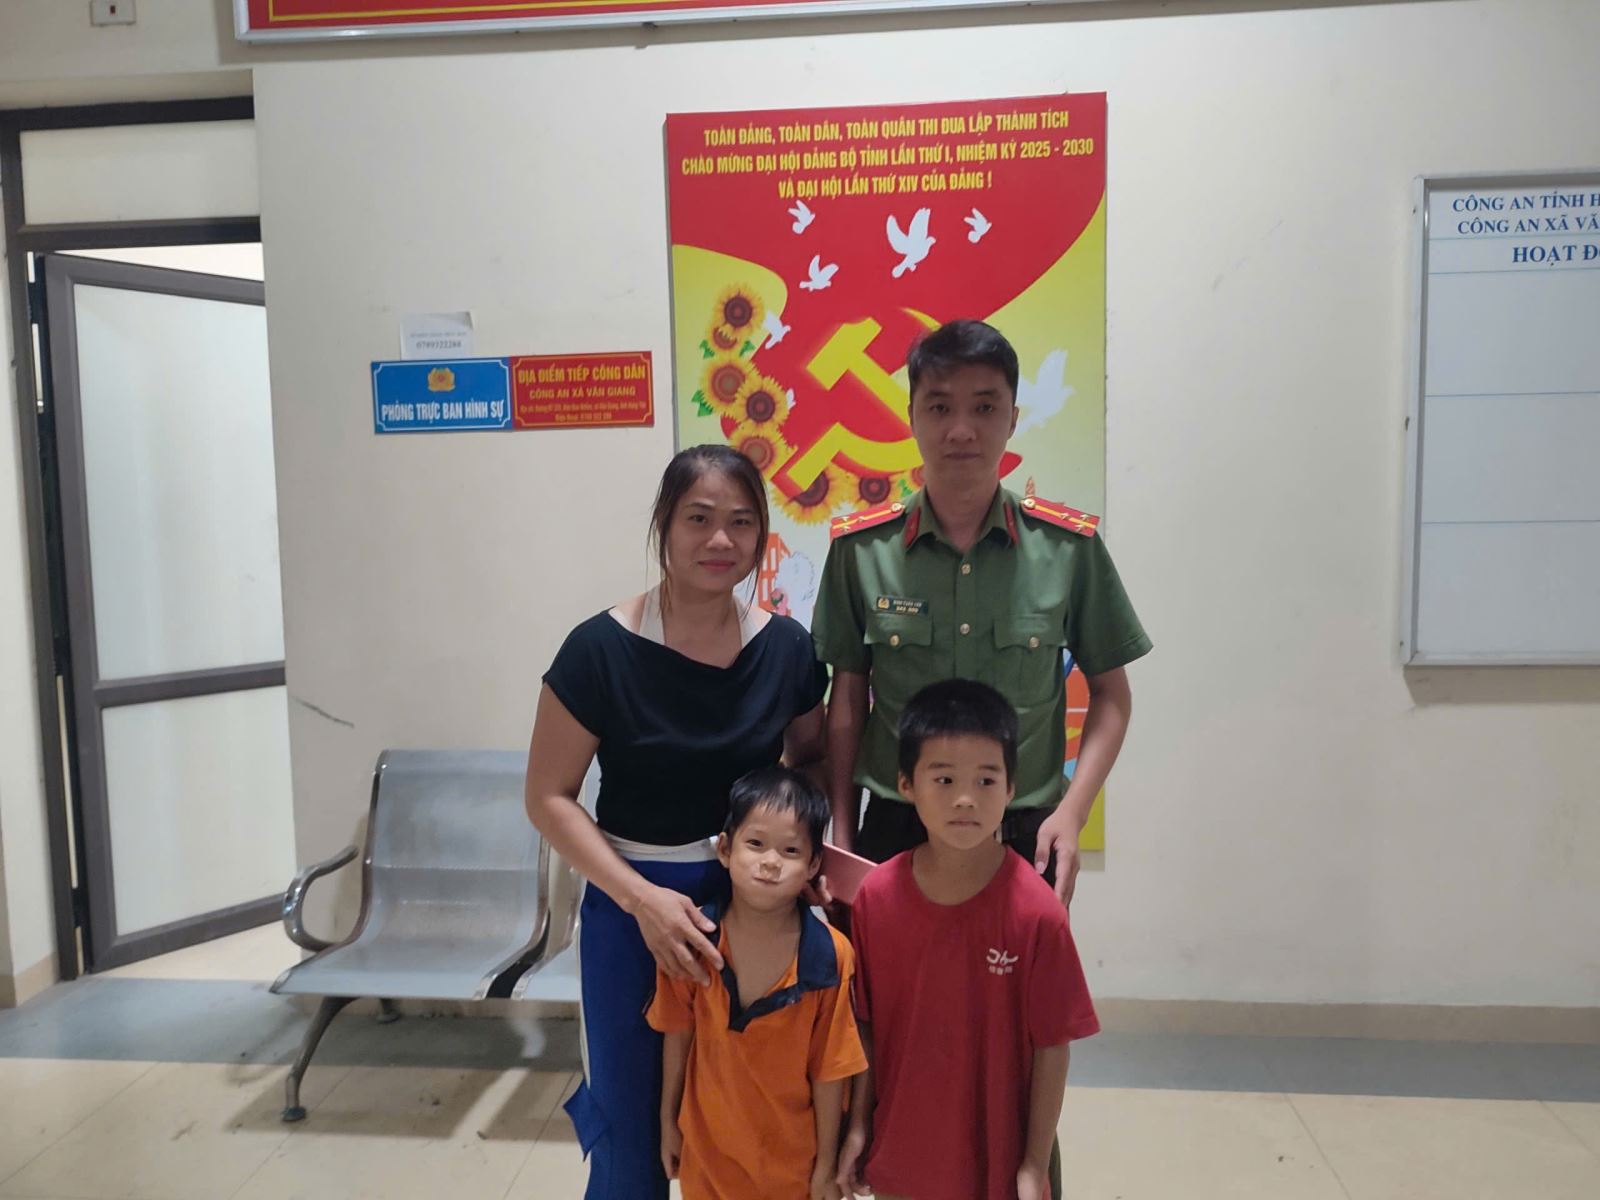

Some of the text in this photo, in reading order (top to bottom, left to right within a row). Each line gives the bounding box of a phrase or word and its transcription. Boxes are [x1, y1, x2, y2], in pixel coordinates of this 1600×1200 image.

[704, 108, 1069, 147] TOÀN ĐẢNG, TOÀN DÂN, TOÀN QUÂN THI ĐUA LẬP THÀNH TÍCH
[681, 154, 714, 175] CHÀO
[716, 152, 753, 174] MỪNG
[756, 154, 777, 175] ĐẠI
[779, 150, 800, 174] HỘI
[803, 147, 837, 170] ĐẢNG
[839, 146, 857, 171] BỘ
[860, 144, 888, 167] TỈNH
[891, 142, 915, 165] LẦN
[918, 141, 943, 164] THỨ
[944, 145, 954, 164] I,
[956, 140, 998, 164] NHIỆM
[1000, 138, 1017, 160] KỲ
[1020, 141, 1051, 159] 2025
[1062, 138, 1094, 156] 2030
[778, 167, 993, 200] VÀ ĐẠI HỘI LẦN THỨ XIV CỦA ĐẢNG !
[1452, 194, 1504, 212] CÔNG
[1509, 196, 1535, 210] AN
[1540, 190, 1584, 209] TỈNH
[1457, 217, 1509, 234] CÔNG
[1514, 218, 1540, 232] AN
[1545, 214, 1569, 231] XÃ
[1512, 244, 1600, 266] HOẠT Đ
[567, 364, 589, 381] TIẾP
[592, 364, 621, 381] CÔNG
[623, 362, 646, 379] DÂN
[529, 389, 555, 399] CÔNG
[557, 389, 570, 398] AN
[607, 386, 636, 396] GIANG
[381, 401, 415, 421] PHÒNG
[416, 400, 441, 424] TRỰC
[442, 402, 463, 419] BAN
[465, 397, 489, 419] HÌNH
[490, 399, 504, 421] SỰ
